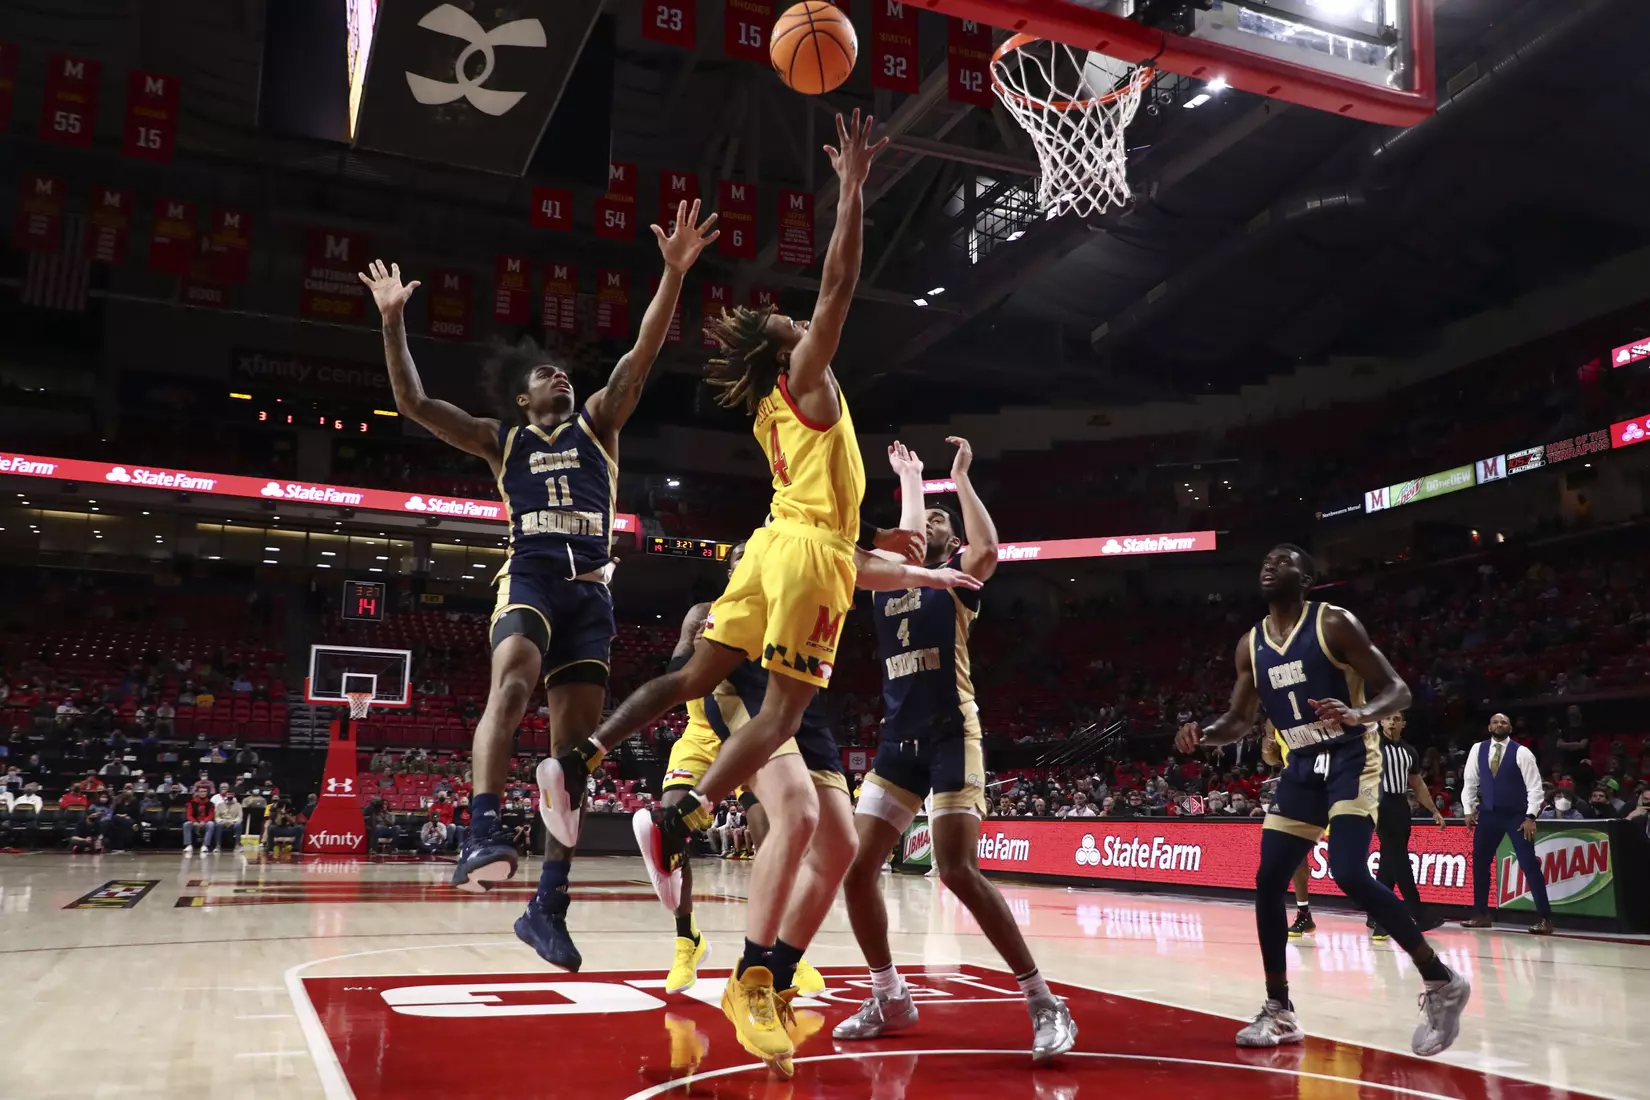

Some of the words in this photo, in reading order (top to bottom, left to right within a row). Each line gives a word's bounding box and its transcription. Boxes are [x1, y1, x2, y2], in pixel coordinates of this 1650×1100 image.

[656, 5, 683, 31] 23
[886, 0, 904, 19] M
[738, 22, 762, 48] 15
[64, 58, 85, 80] M
[883, 53, 908, 79] 32
[144, 75, 165, 96] M
[959, 67, 983, 93] 42
[54, 110, 82, 135] 55
[136, 126, 163, 150] 15
[36, 177, 53, 195] M
[671, 174, 687, 191] M
[731, 184, 746, 201] M
[104, 190, 122, 208] M
[541, 199, 563, 220] 41
[789, 194, 804, 210] M
[168, 202, 185, 220] M
[224, 212, 241, 229] M
[604, 209, 627, 231] 54
[324, 234, 350, 262] M
[732, 229, 744, 247] 6
[507, 258, 521, 273] M
[554, 264, 568, 280] M
[443, 274, 460, 291] M
[607, 272, 621, 287] M
[712, 283, 724, 300] M
[759, 291, 771, 304] M
[432, 320, 464, 337] 2002
[237, 353, 313, 384] xfinity
[317, 364, 392, 390] cente
[1546, 438, 1574, 453] HOME
[1575, 434, 1589, 446] OF
[1589, 429, 1608, 441] THE
[1546, 439, 1610, 464] TERRAPINS
[529, 447, 581, 474] GEORGE
[771, 420, 792, 488] 4
[0, 455, 53, 475] eFarm
[1483, 457, 1498, 477] M
[545, 474, 574, 507] 11
[1371, 490, 1384, 509] M
[521, 509, 604, 537] WASHINGTON
[676, 540, 693, 548] 3:27
[702, 548, 713, 557] 23
[997, 544, 1037, 561] eFarm
[358, 597, 377, 616] 14
[807, 604, 844, 649] M
[896, 617, 911, 648] 4
[885, 646, 941, 681] ASHINGTON
[1267, 659, 1308, 690] GEORGE
[1287, 690, 1303, 721] 1
[1280, 717, 1346, 750] ASHINGTON
[308, 829, 365, 850] xfinity
[903, 829, 932, 863] LIBMA
[1498, 840, 1610, 907] LIMAN
